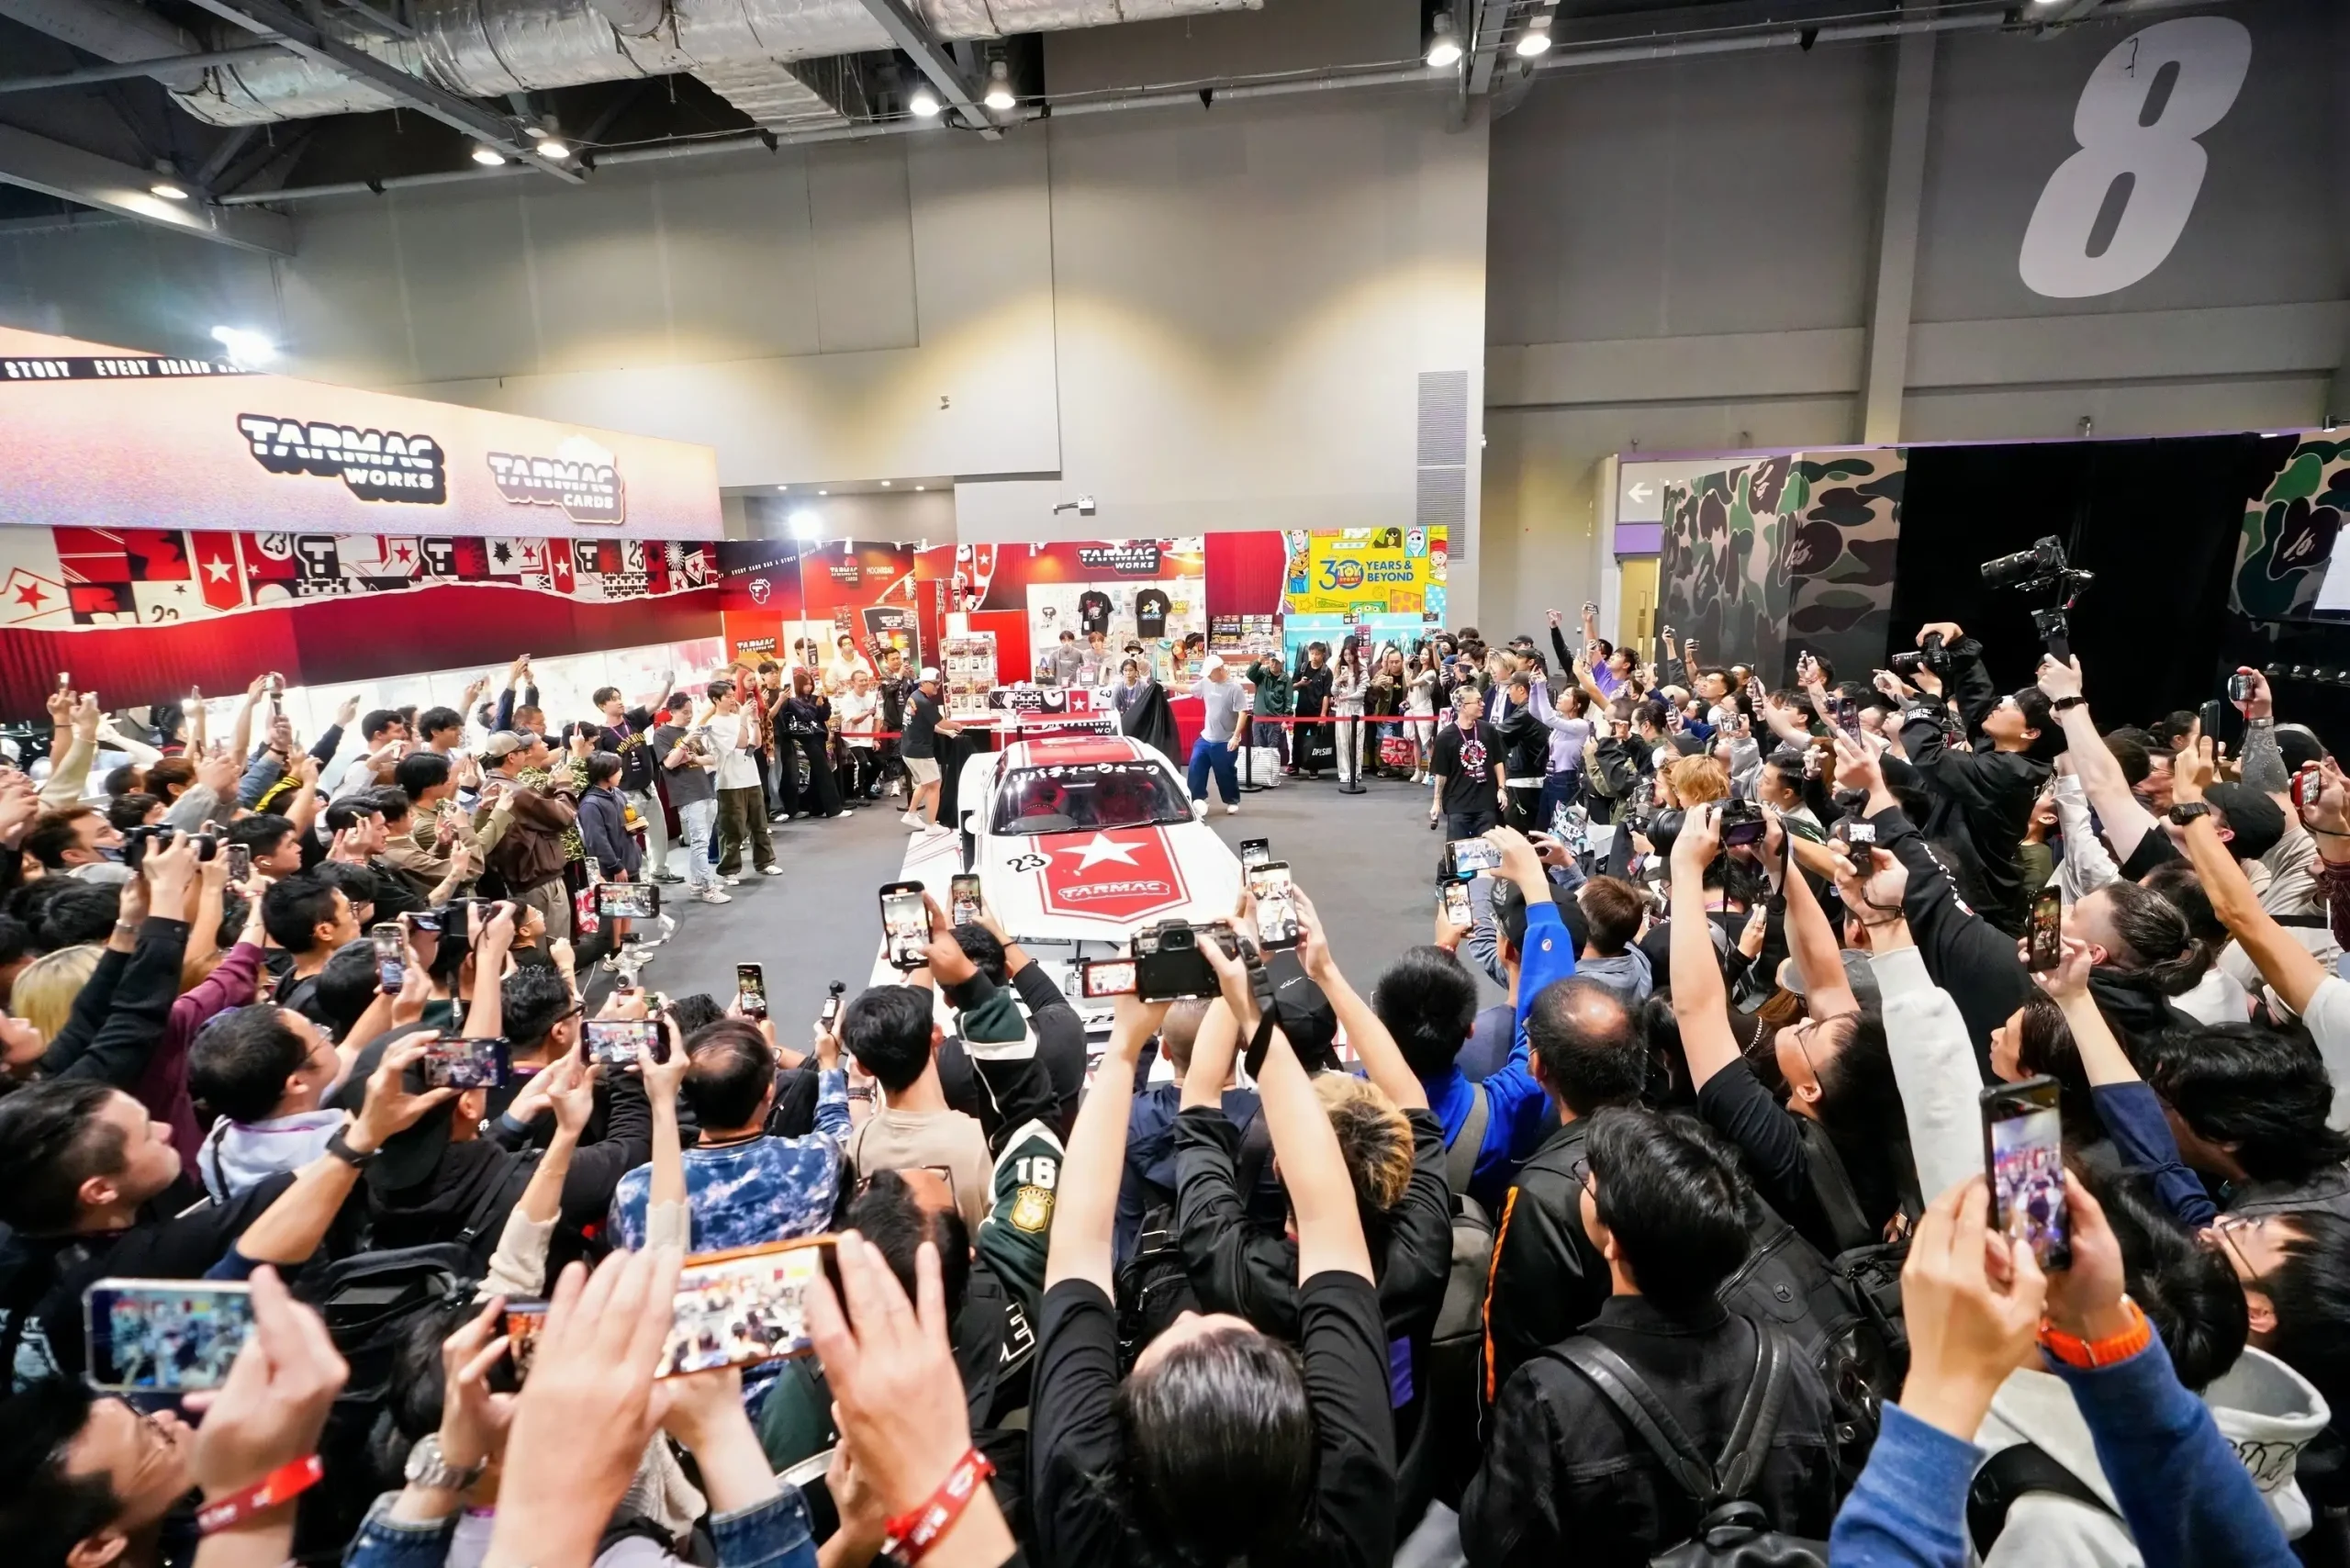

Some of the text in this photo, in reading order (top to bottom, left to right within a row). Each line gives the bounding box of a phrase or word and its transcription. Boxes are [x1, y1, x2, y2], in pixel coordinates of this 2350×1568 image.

[2018, 15, 2253, 299] 8
[5, 360, 71, 379] STORY
[94, 359, 151, 376] EVERY
[241, 418, 433, 468] TARMAC
[347, 466, 435, 489] WORKS
[489, 457, 613, 495] TARMAC
[563, 493, 614, 510] CARDS
[1079, 547, 1158, 562] TARMAC
[1114, 561, 1155, 569] WORKS
[1337, 565, 1362, 577] TOY
[1366, 560, 1412, 570] YEARS &
[1367, 572, 1415, 582] BEYOND
[1006, 854, 1047, 873] 23
[1060, 881, 1163, 899] TARMAC
[1015, 1156, 1056, 1189] 16
